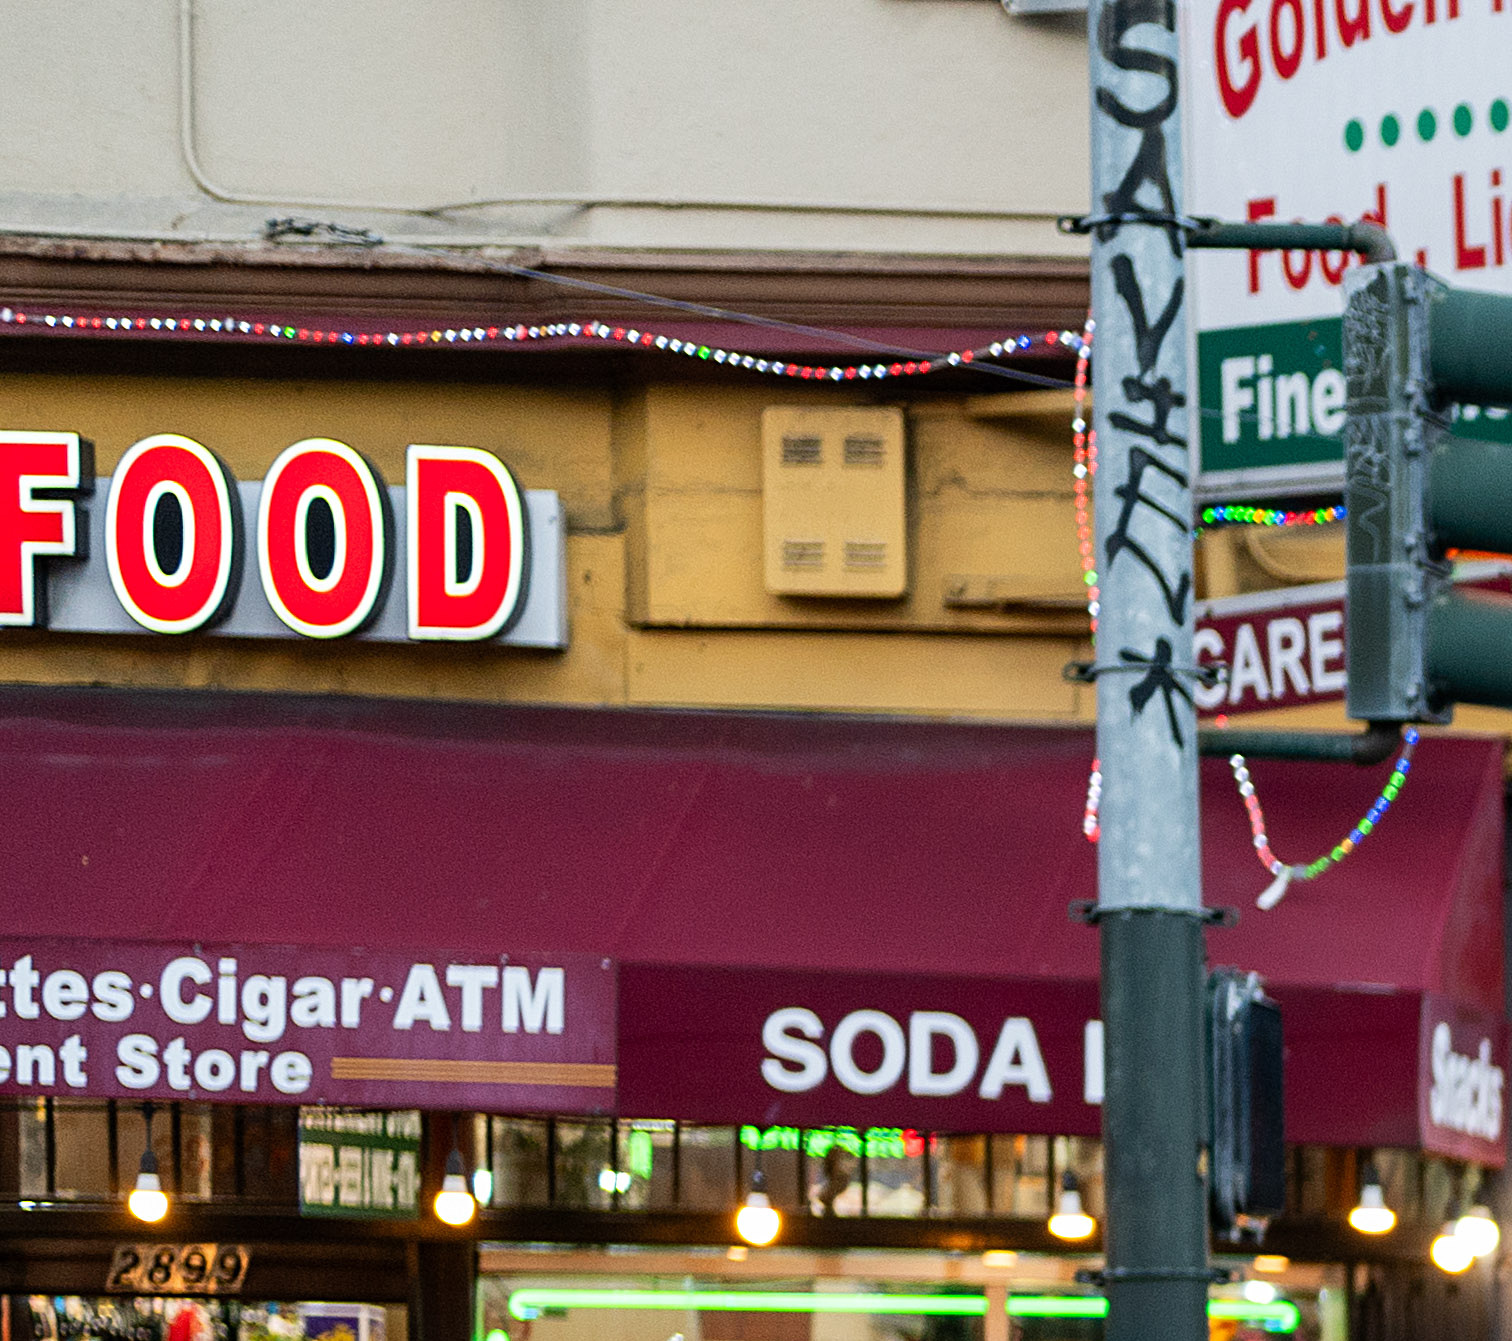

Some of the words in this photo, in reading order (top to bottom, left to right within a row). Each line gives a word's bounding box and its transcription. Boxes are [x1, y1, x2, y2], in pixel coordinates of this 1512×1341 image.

[1220, 355, 1347, 443] Fine
[0, 430, 527, 641] FOOD
[0, 955, 136, 1022] tes
[160, 956, 374, 1043] Cigar
[393, 963, 566, 1035] ATM
[0, 1034, 88, 1088] nt
[115, 1034, 314, 1093] Store
[760, 1006, 1053, 1104] SODA
[110, 1248, 243, 1286] 2899
